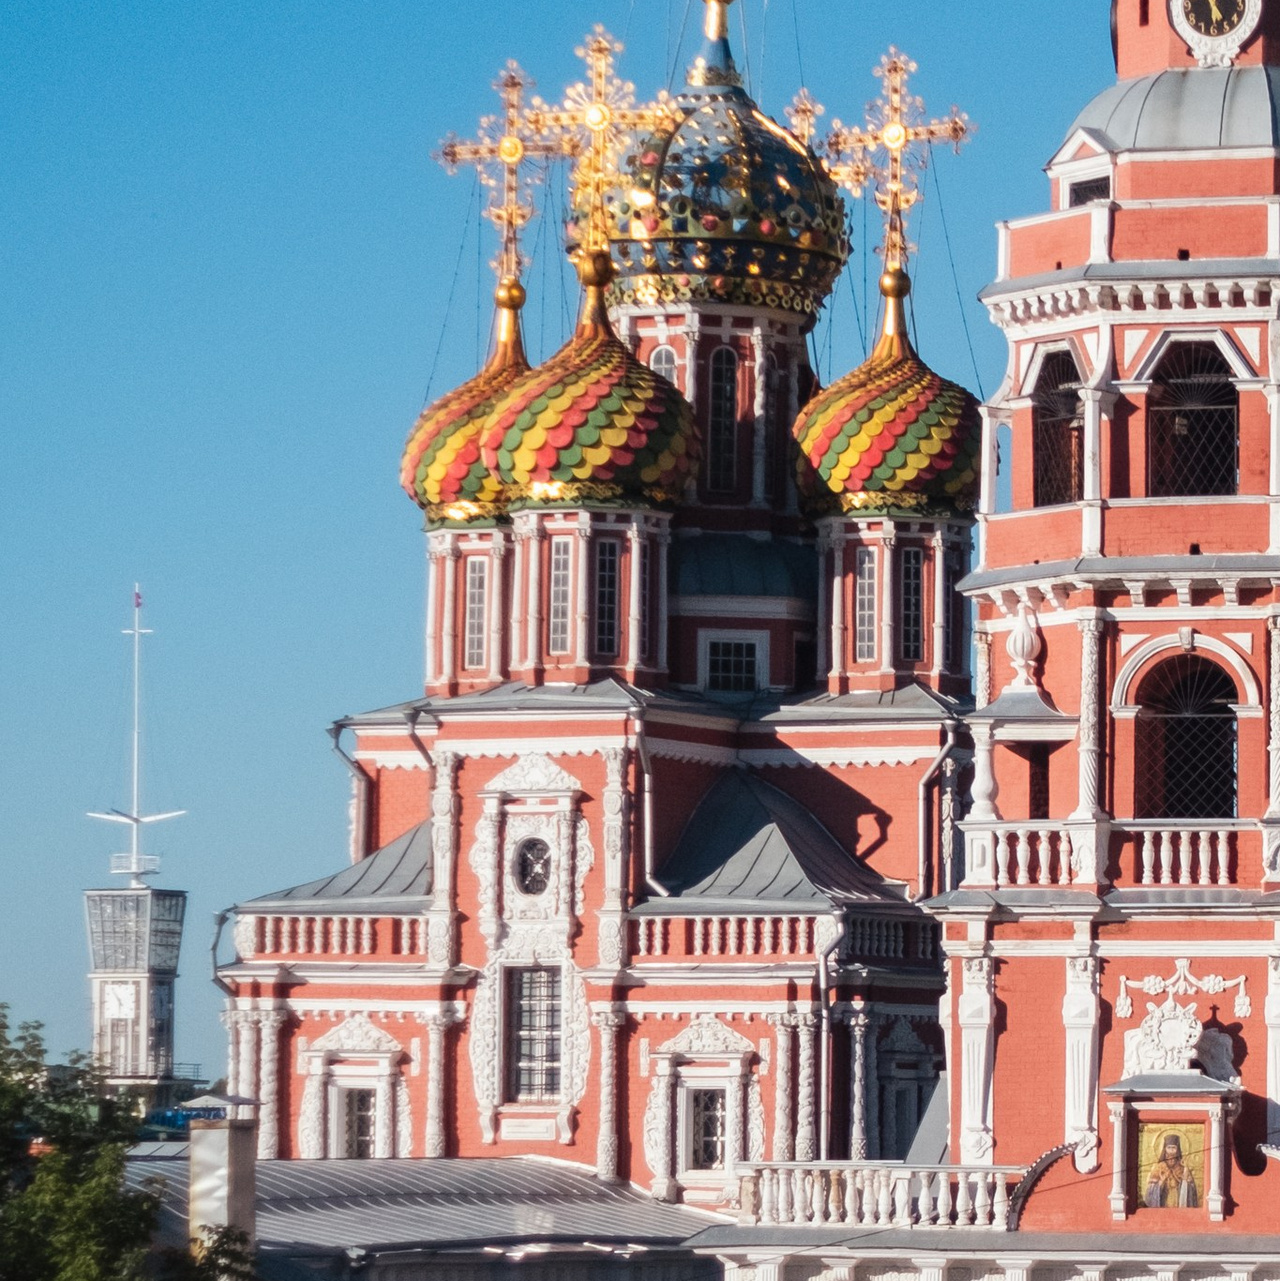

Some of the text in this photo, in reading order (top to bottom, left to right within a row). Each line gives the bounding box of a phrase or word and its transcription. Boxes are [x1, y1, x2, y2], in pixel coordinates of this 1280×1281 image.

[1183, 0, 1191, 12] 9
[1237, 0, 1243, 11] 3
[1188, 13, 1196, 26] 8
[1231, 13, 1238, 25] 4
[1198, 22, 1205, 33] 7
[1210, 23, 1218, 36] 6
[1223, 21, 1230, 33] 5
